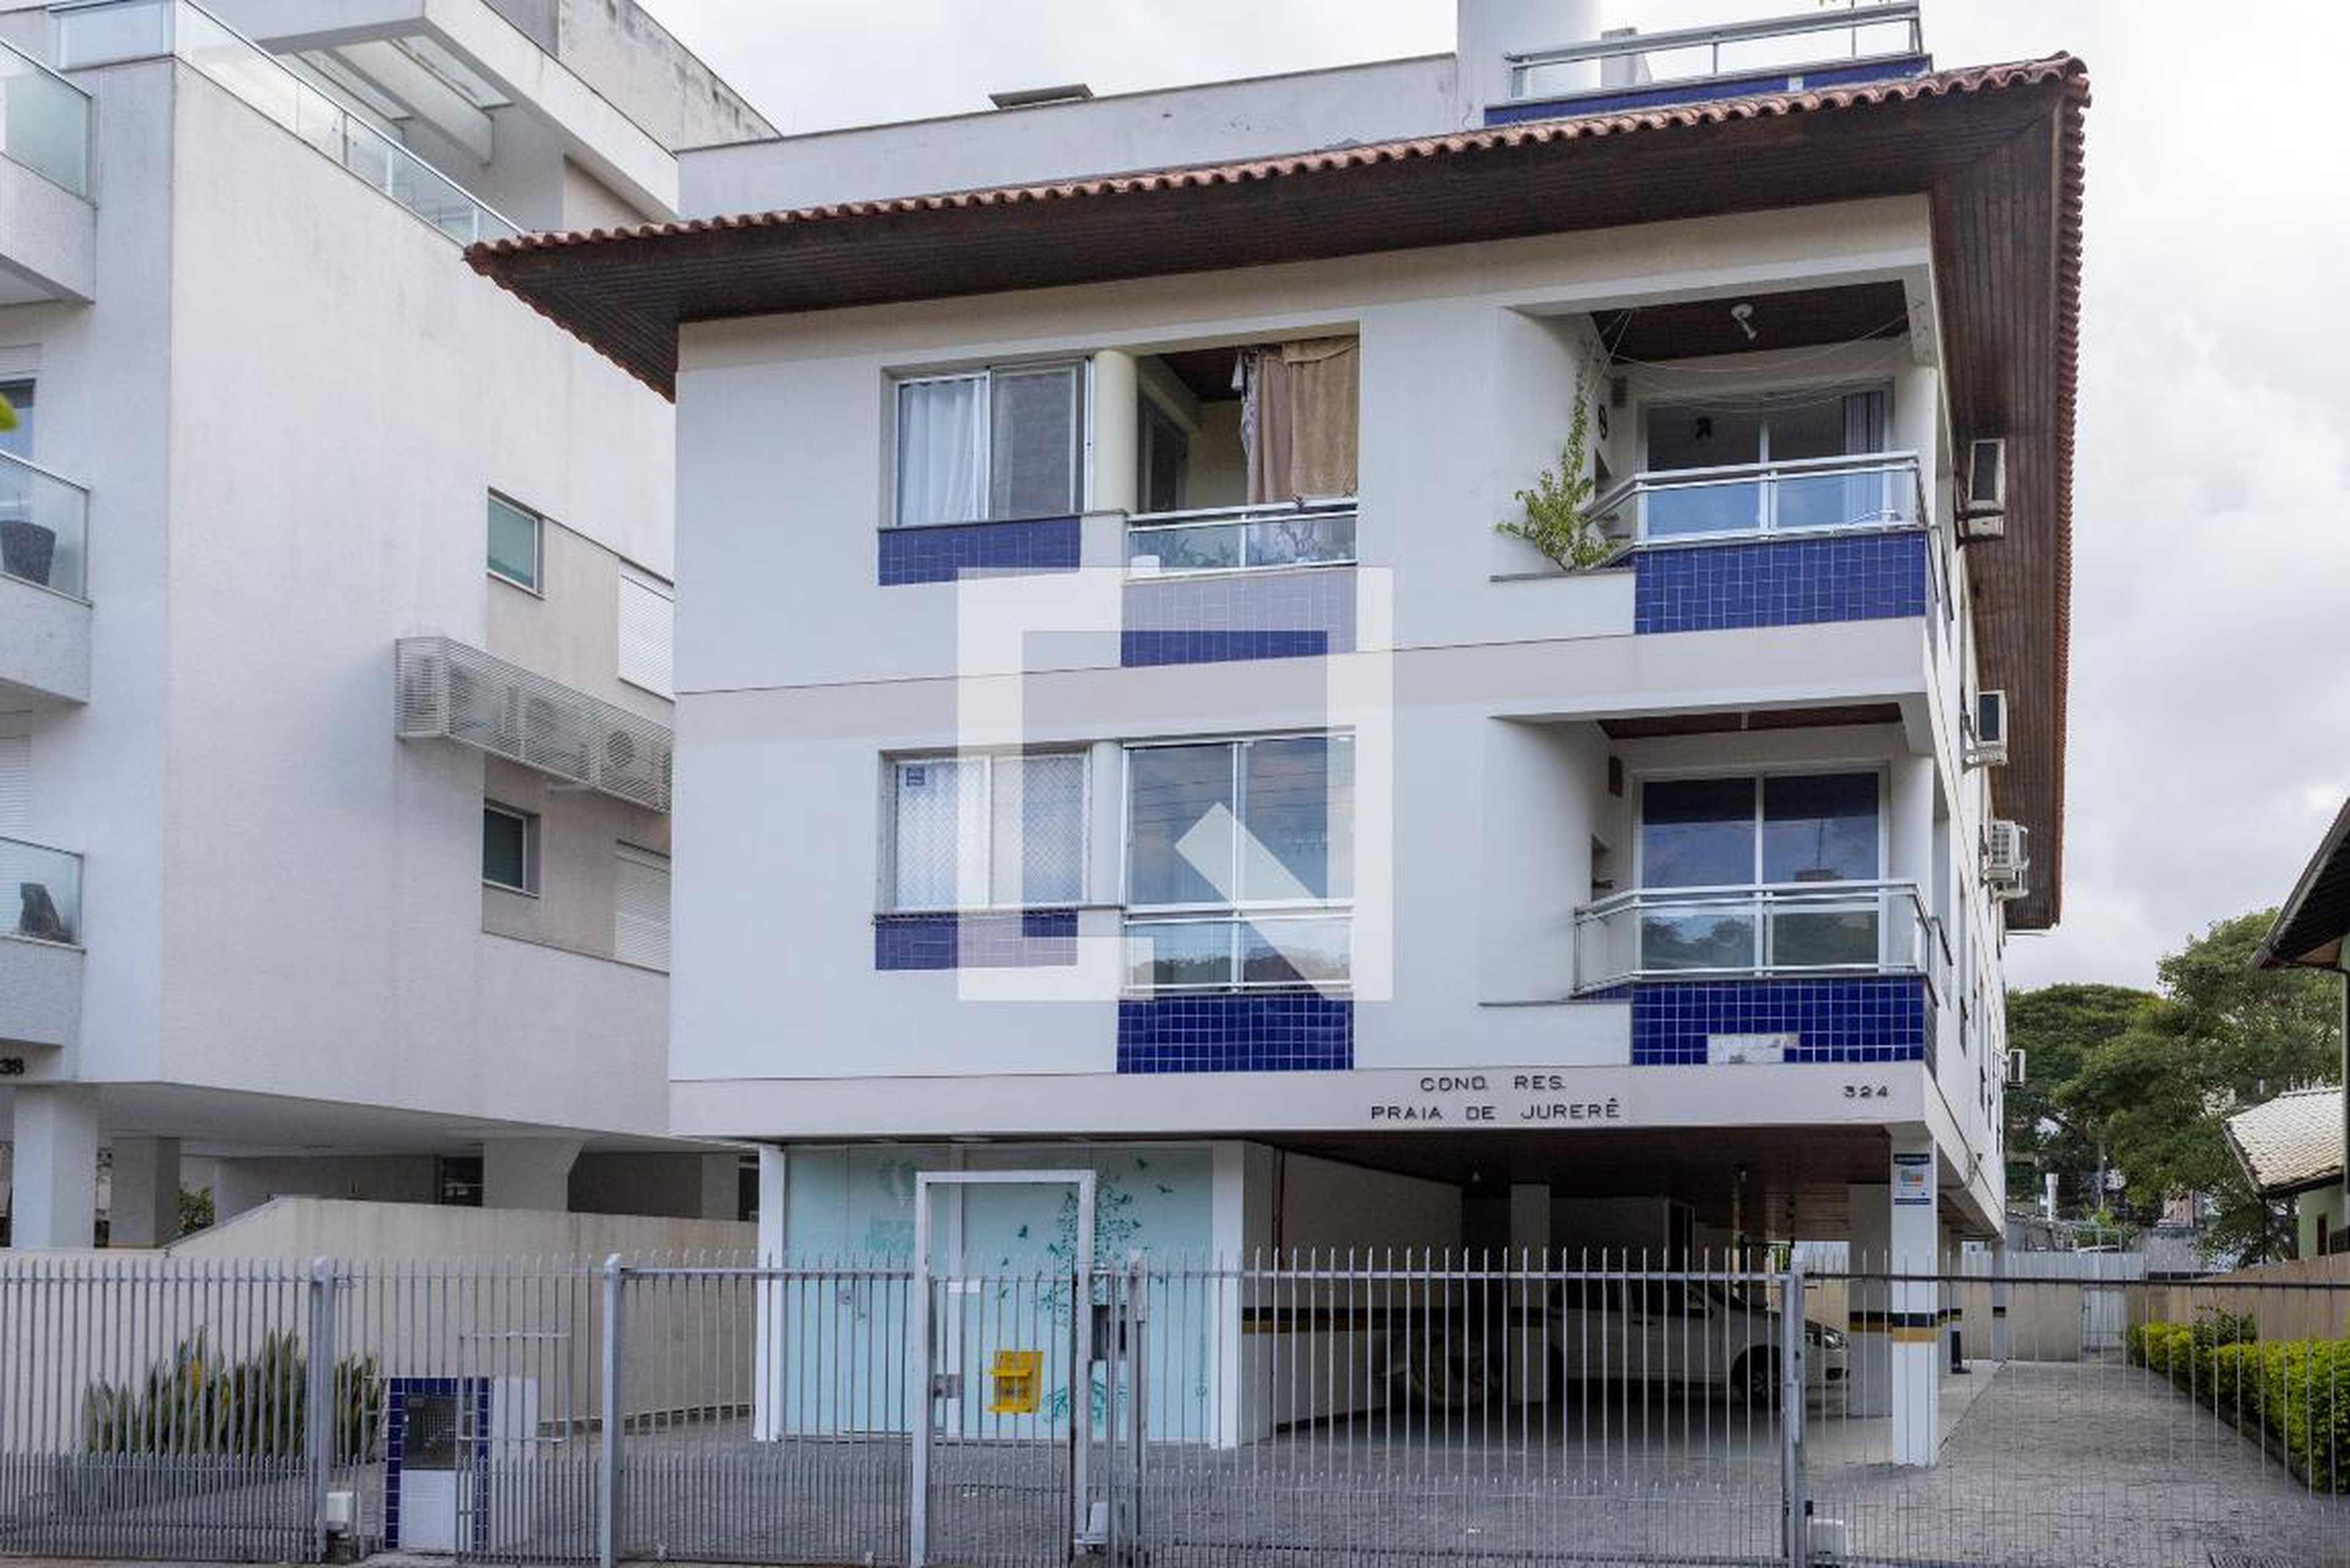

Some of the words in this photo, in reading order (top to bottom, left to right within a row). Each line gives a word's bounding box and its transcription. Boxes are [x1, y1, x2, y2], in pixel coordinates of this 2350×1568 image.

[1845, 1085, 1887, 1099] 324
[1371, 1106, 1442, 1120] PRAIA
[1466, 1106, 1496, 1120] DE
[1521, 1098, 1620, 1119] JURERÊ
